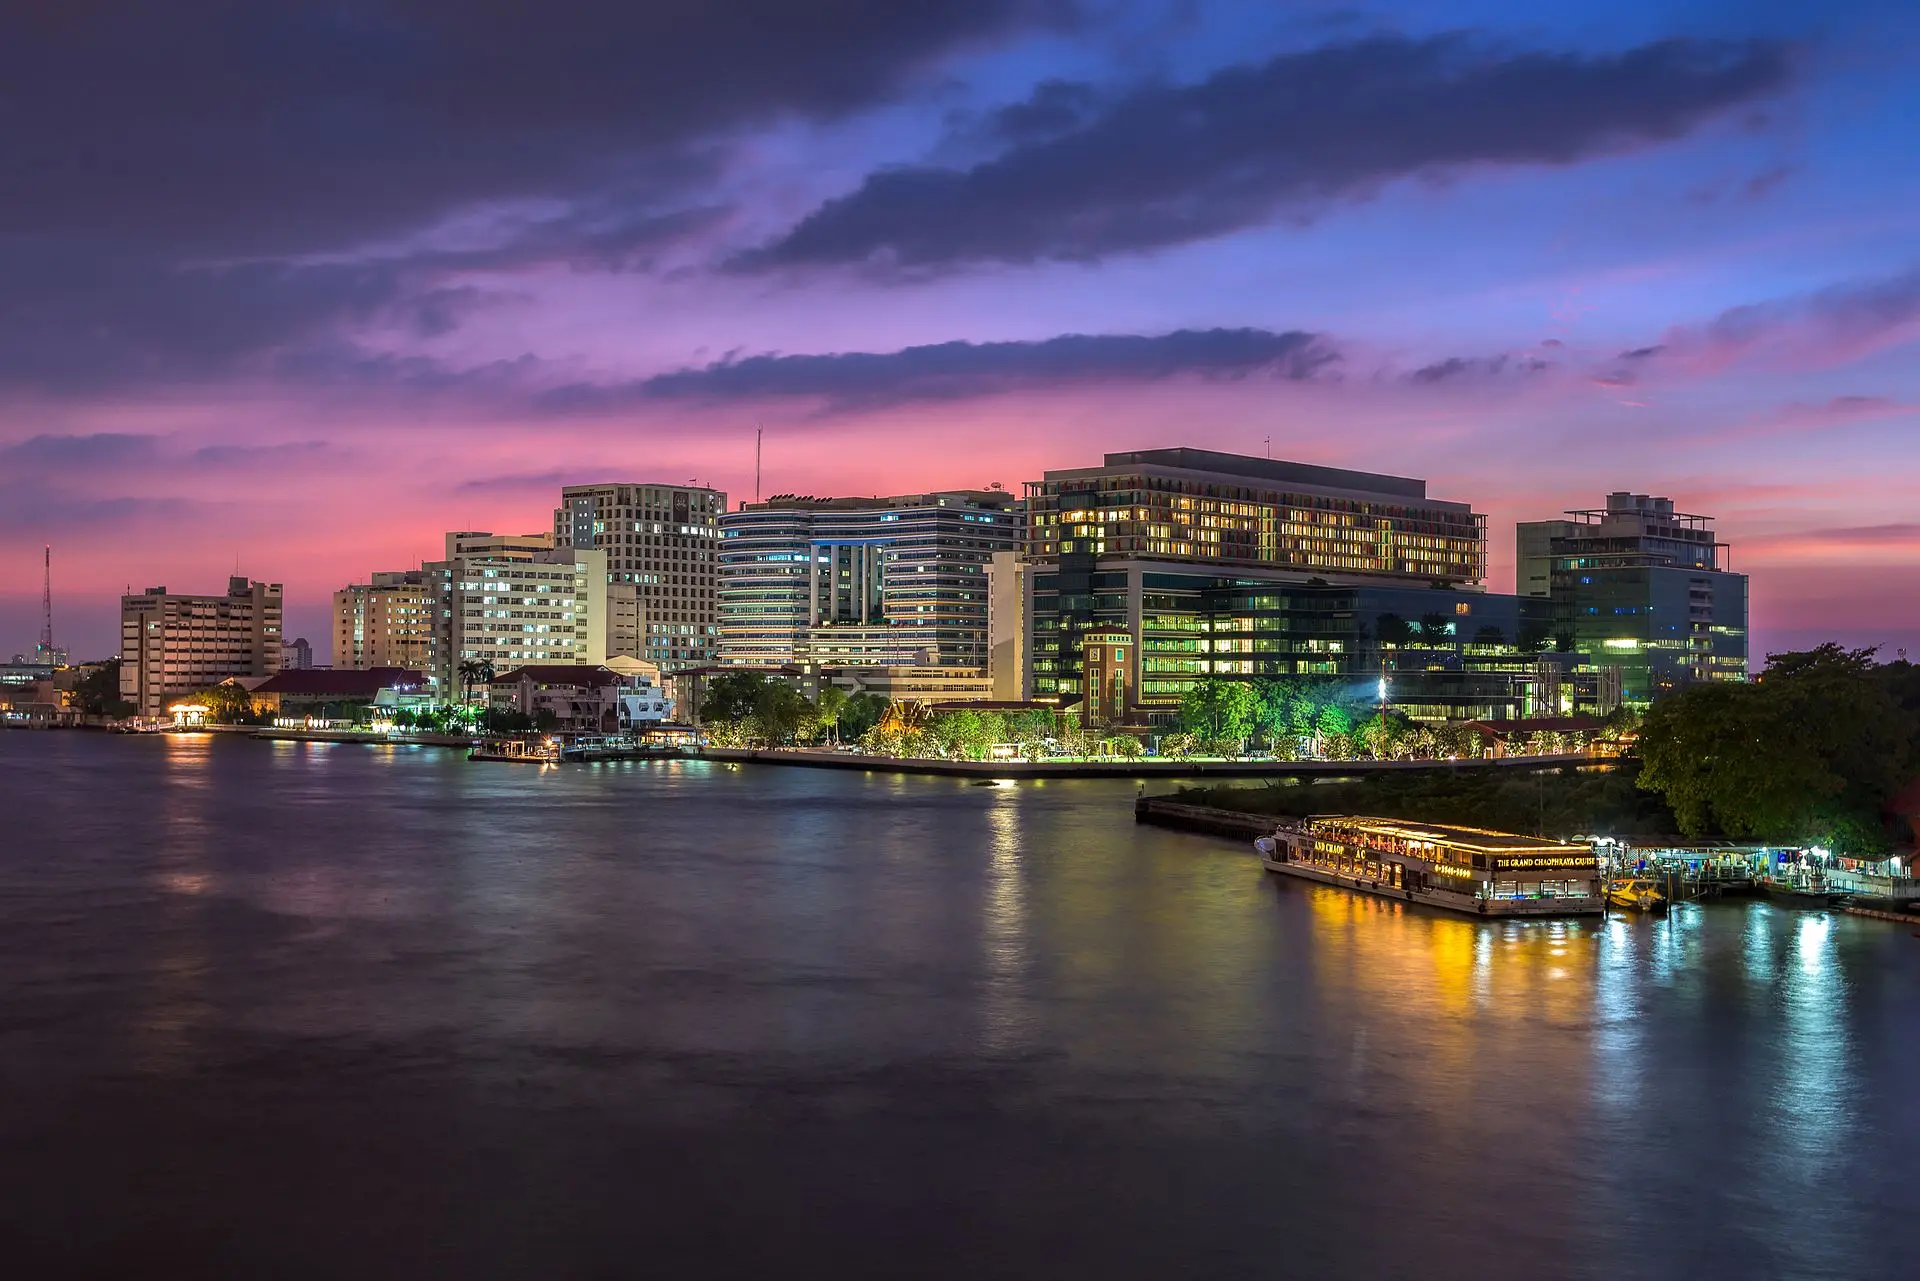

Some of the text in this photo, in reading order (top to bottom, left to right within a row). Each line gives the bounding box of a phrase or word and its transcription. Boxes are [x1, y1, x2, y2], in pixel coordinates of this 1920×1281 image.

[1497, 857, 1596, 867] THE GRAND CHAOPHRAYA CRUISE
